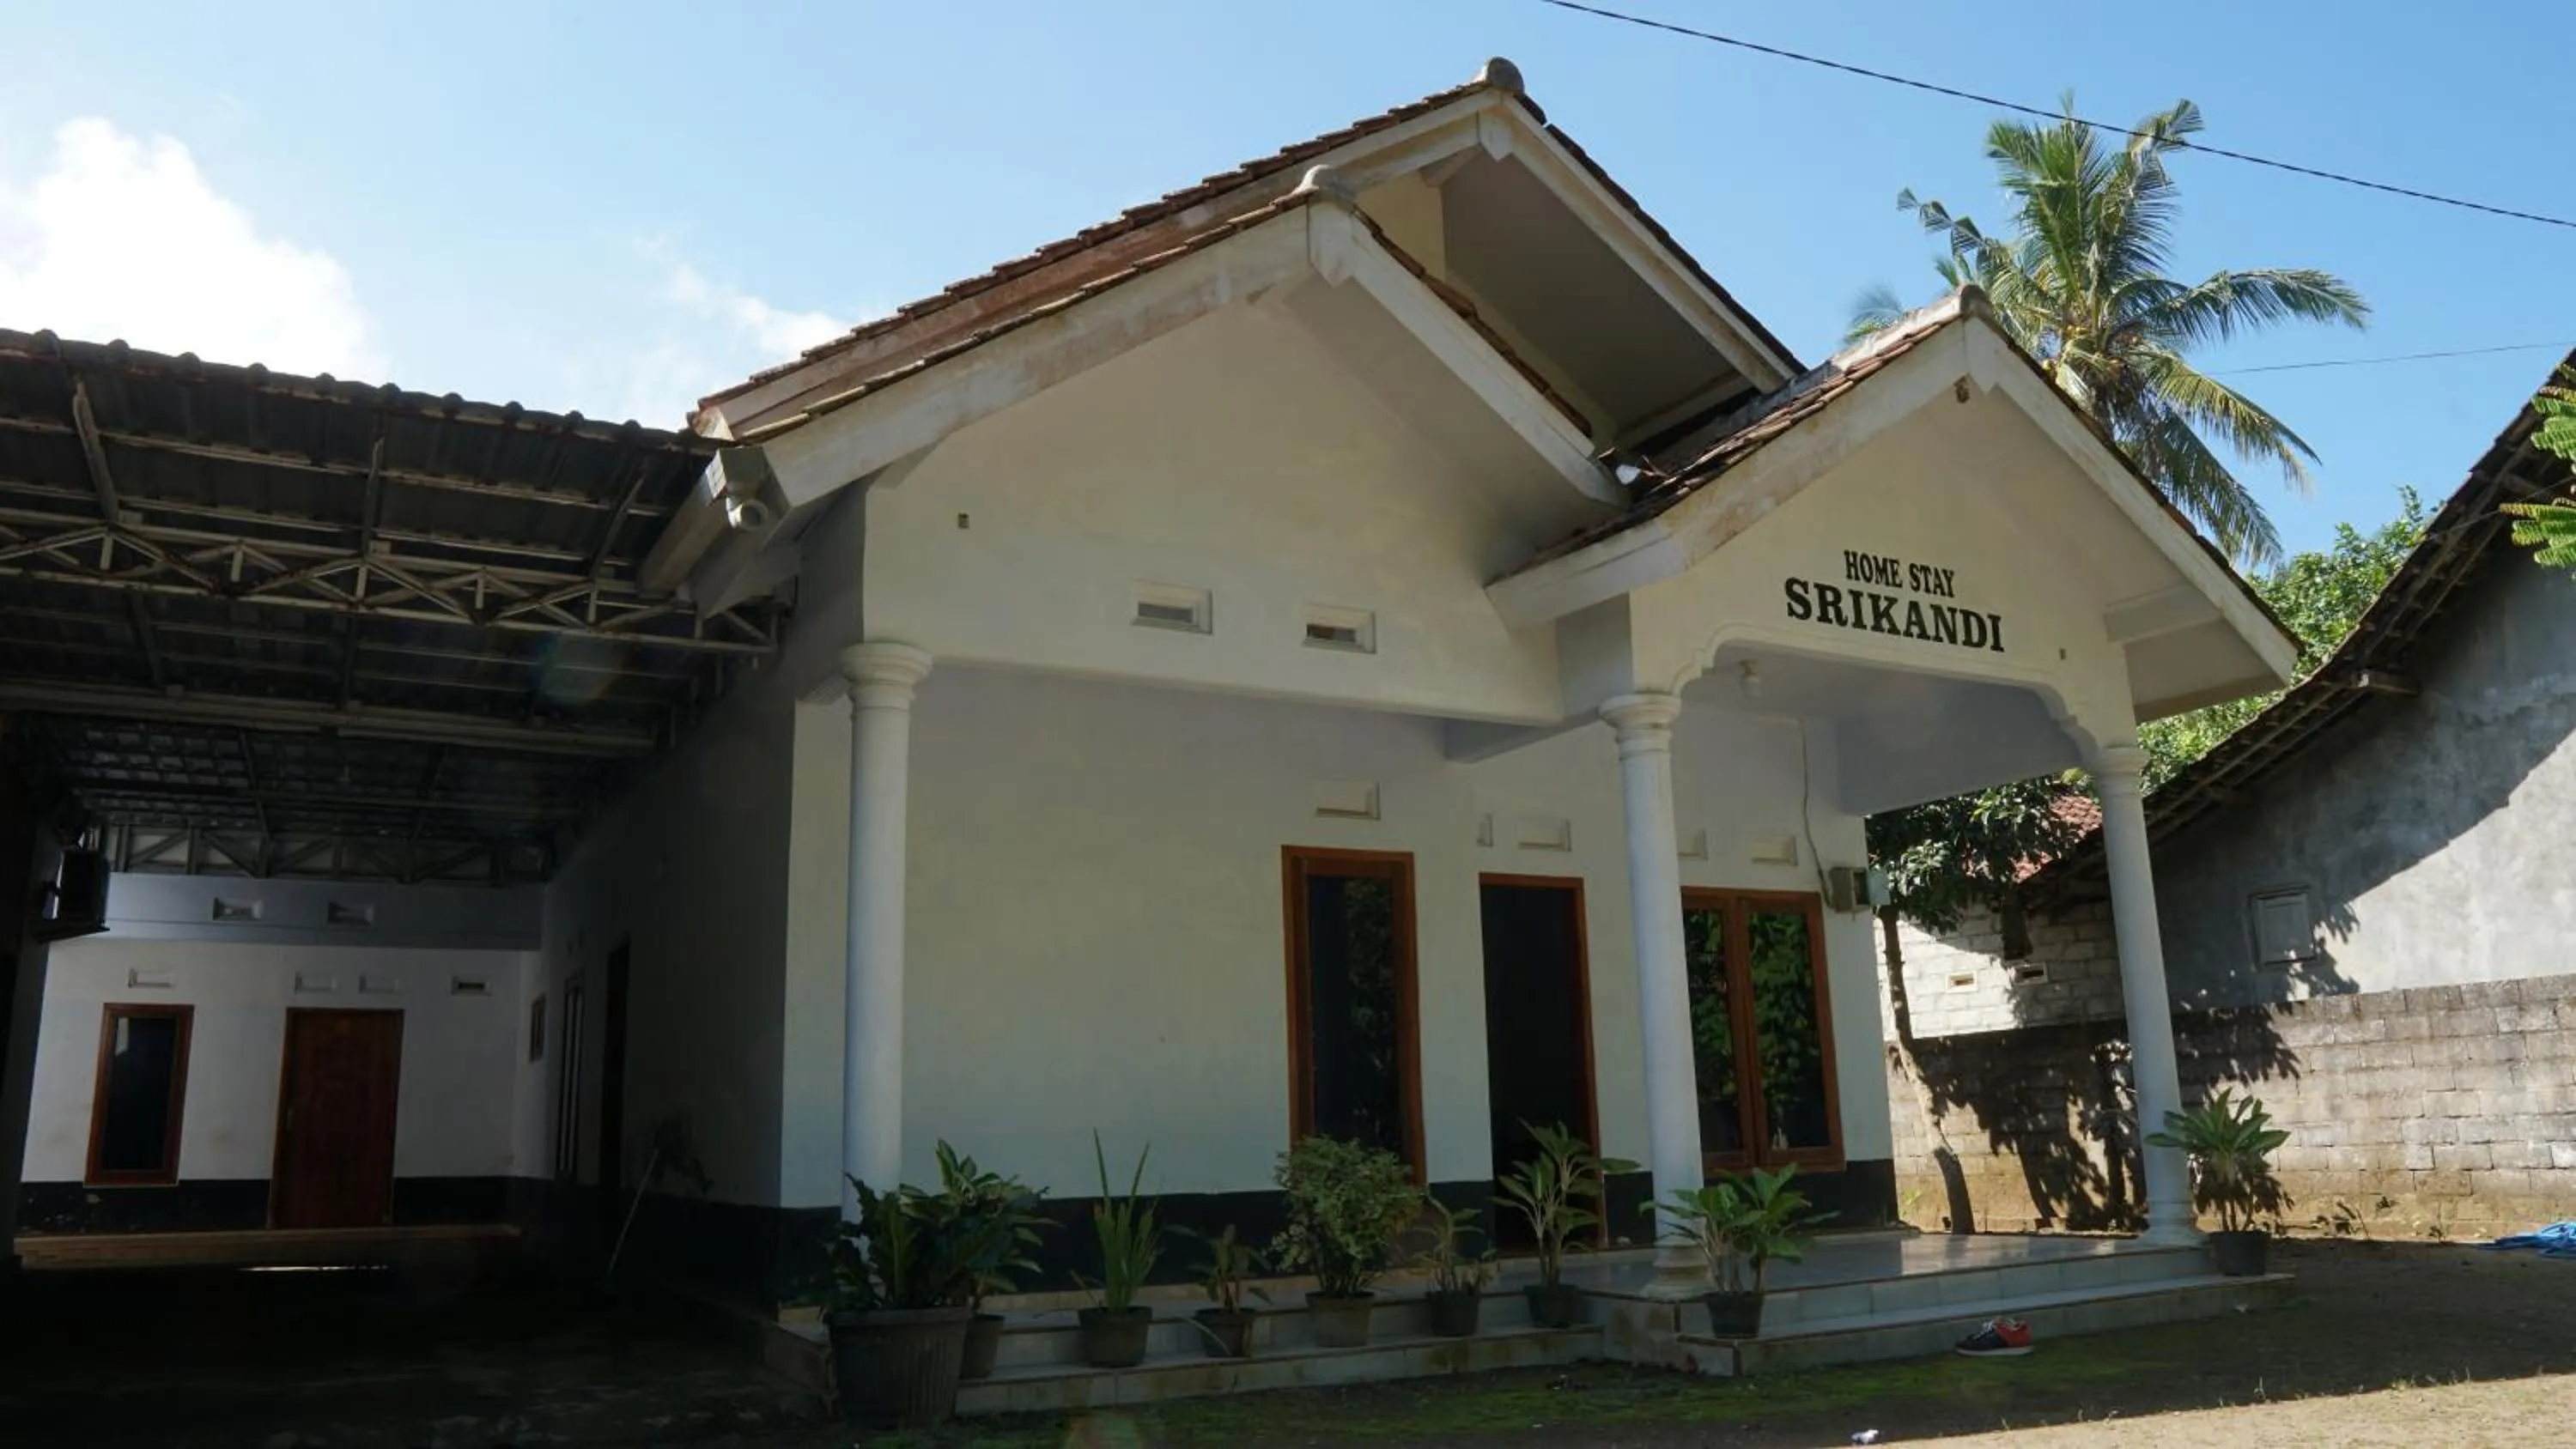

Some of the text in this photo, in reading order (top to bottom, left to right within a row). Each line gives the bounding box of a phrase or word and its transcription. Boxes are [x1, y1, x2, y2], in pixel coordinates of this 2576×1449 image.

[1844, 549, 1955, 598] HOME STAY
[1783, 577, 2005, 652] SRIKANDI
